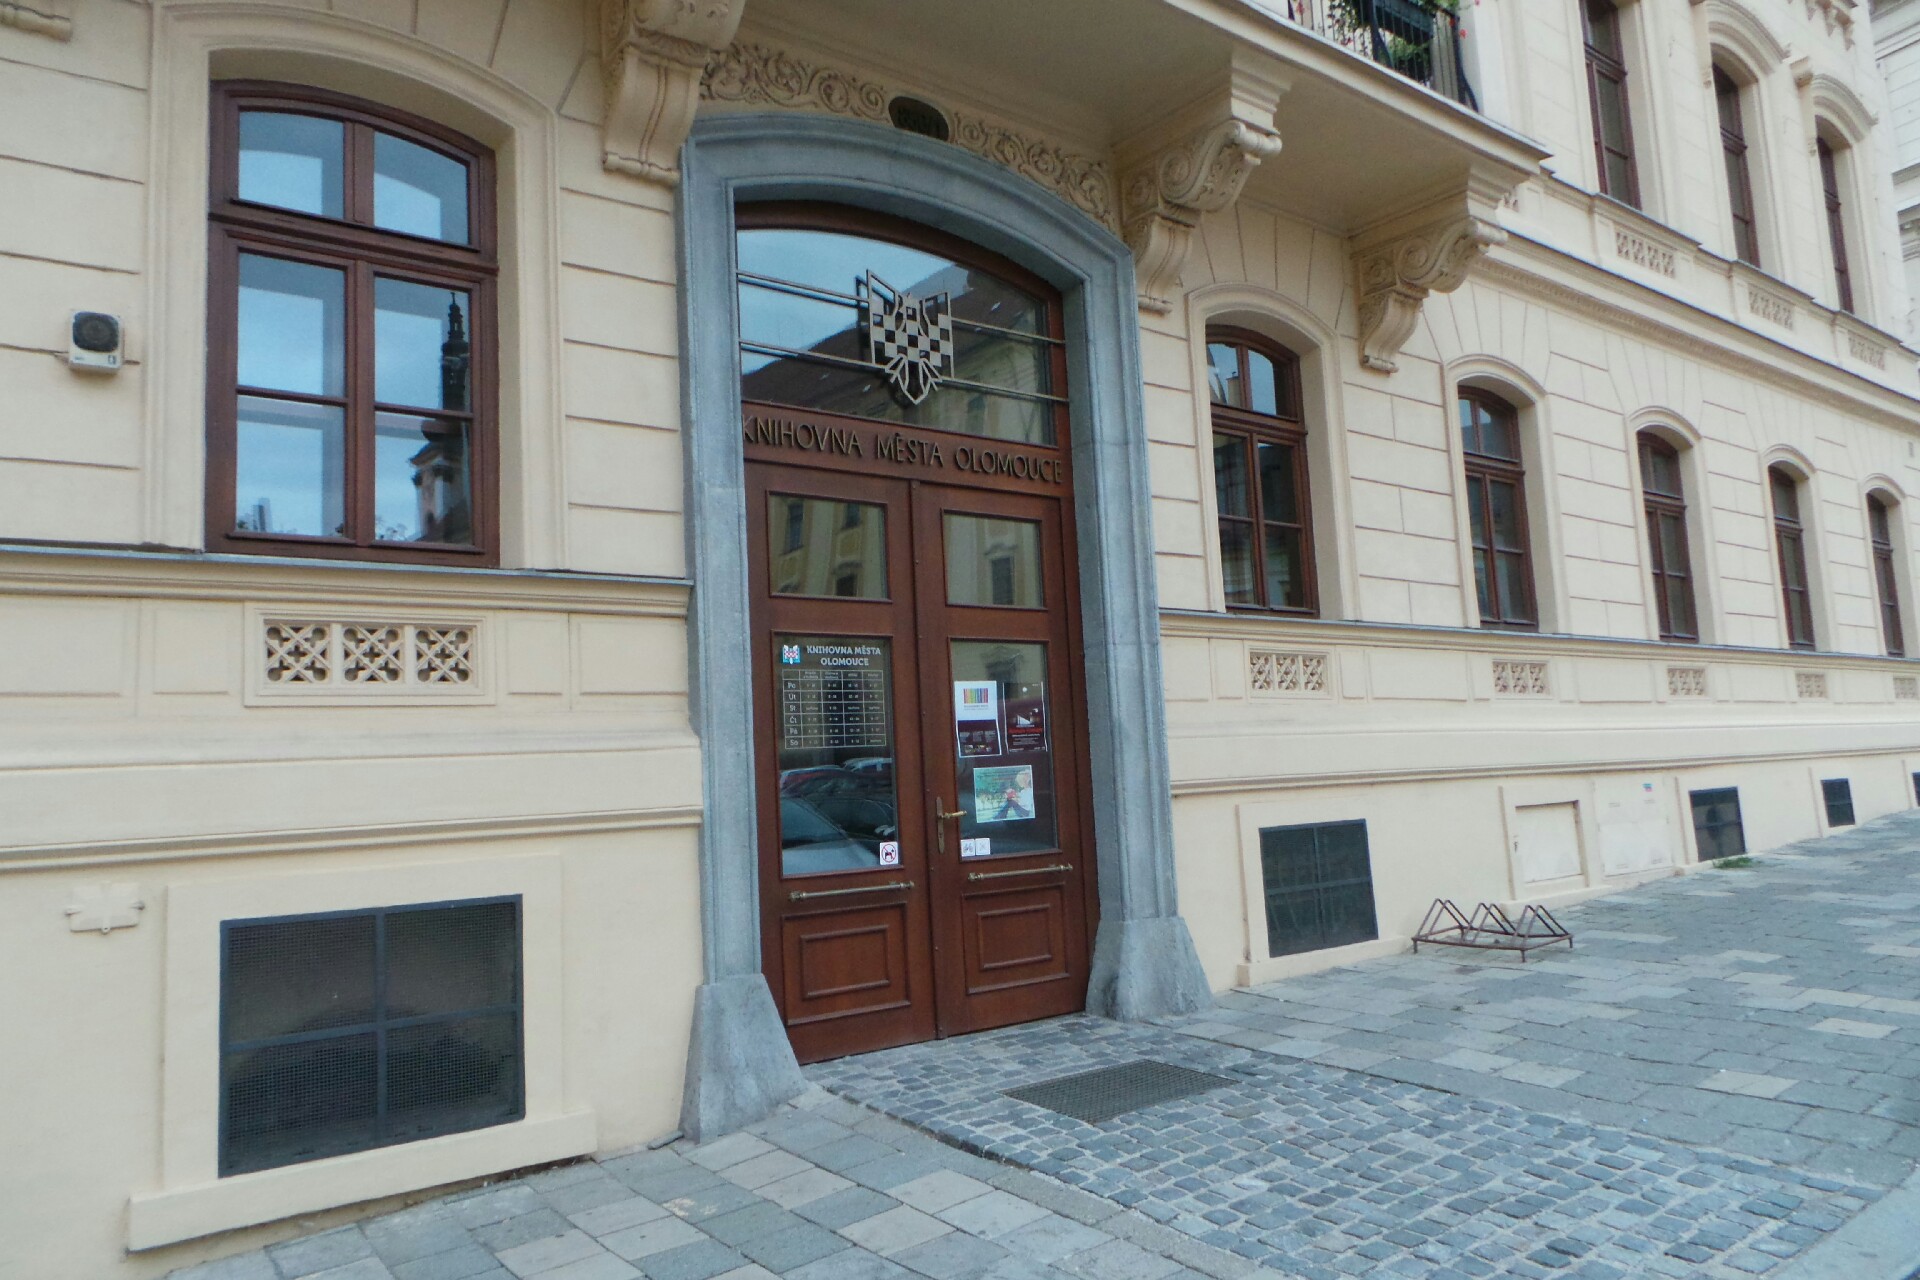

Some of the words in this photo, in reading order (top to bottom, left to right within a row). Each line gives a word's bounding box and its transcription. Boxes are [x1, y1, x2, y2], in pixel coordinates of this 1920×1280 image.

[742, 414, 863, 457] KNIHOVNA
[876, 432, 944, 468] MĚSTA
[955, 446, 1063, 484] OLOMOUCE
[806, 645, 853, 655] KNIHOVNA
[854, 645, 881, 656] MĚSTA
[820, 657, 869, 666] OLOMOUCE
